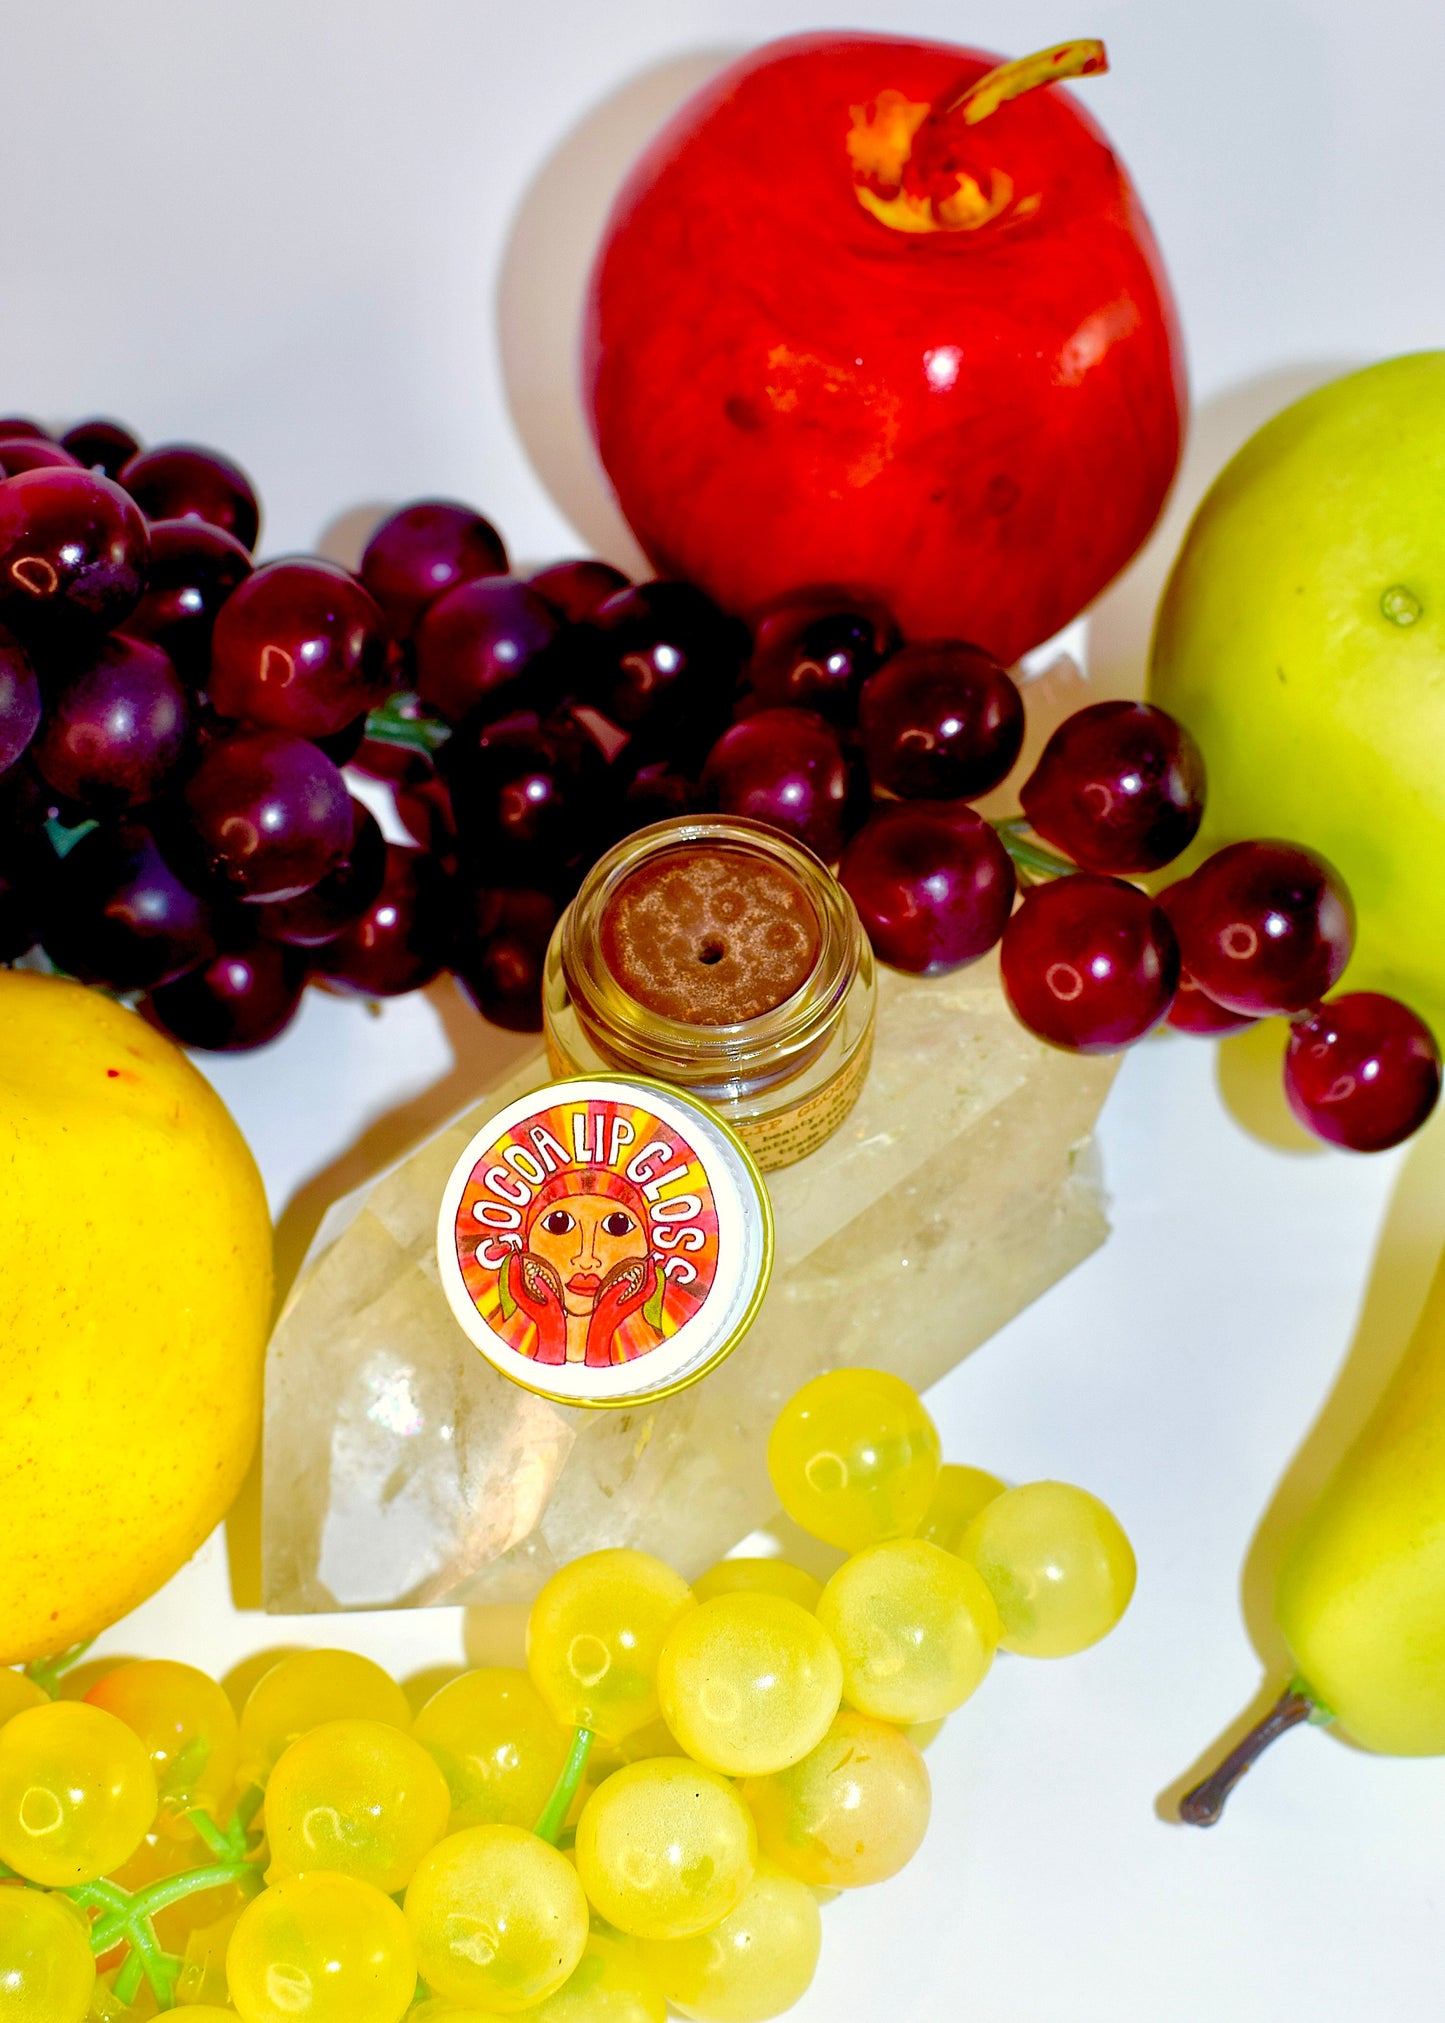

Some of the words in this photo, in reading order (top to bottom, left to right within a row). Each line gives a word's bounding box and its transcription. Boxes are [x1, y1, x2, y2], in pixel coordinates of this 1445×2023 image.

[736, 1119, 783, 1138] LIP
[472, 1126, 572, 1270] COCOA
[571, 1112, 636, 1167] LIP
[625, 1140, 706, 1285] GLOSS
